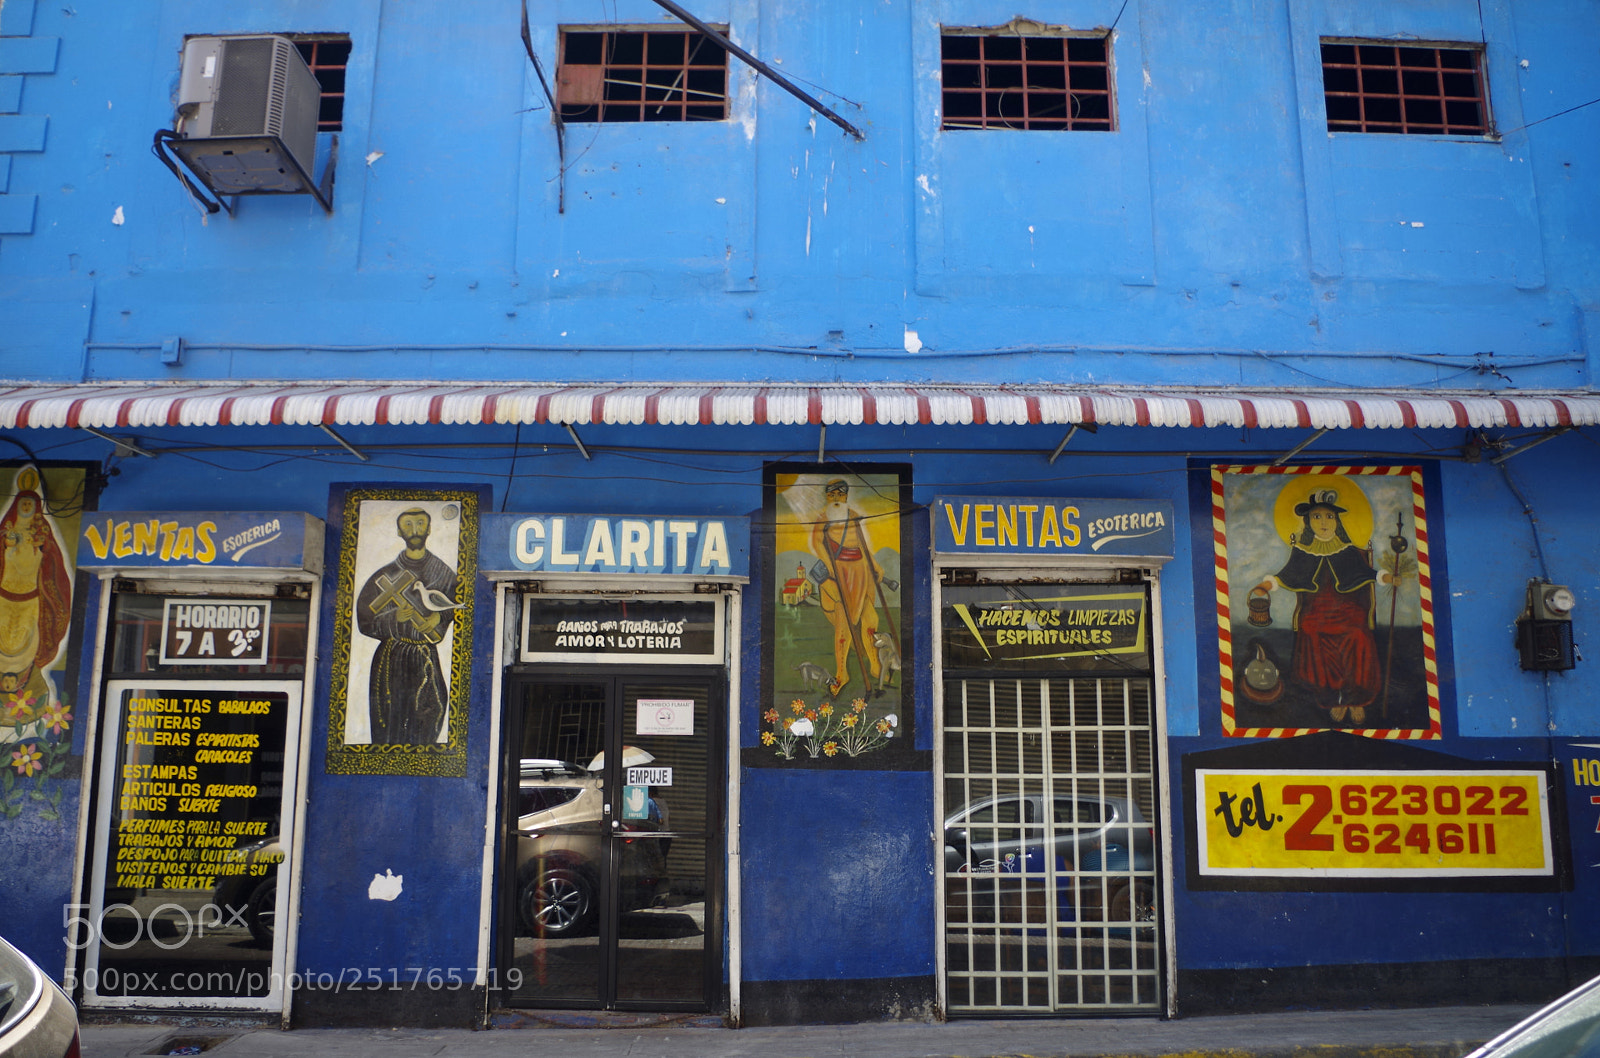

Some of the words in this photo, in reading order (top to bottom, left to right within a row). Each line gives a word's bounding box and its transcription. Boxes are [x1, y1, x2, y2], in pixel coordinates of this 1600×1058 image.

[944, 503, 1081, 548] VENTAS
[1088, 511, 1165, 539] ESOTERICA
[84, 518, 217, 564] VENTAS
[222, 518, 281, 553] ESOTERICA
[509, 517, 731, 574] CLARITA
[176, 605, 260, 628] HORARIO
[978, 609, 1061, 627] HACEMOS
[1068, 609, 1137, 626] LIMPIEZAS
[556, 620, 599, 633] BAÑOS
[619, 619, 684, 635] TRABAJOS
[176, 630, 192, 656] 7
[198, 631, 216, 656] A
[555, 634, 606, 648] AMOR
[607, 635, 615, 647] Y
[618, 635, 682, 649] LOTERIA
[996, 629, 1113, 646] ESPIRITUALES
[128, 698, 212, 714] CONSULTAS
[218, 700, 271, 715] BABALAOS
[127, 715, 202, 730] SANTERAS
[125, 731, 191, 746] PALERAS
[195, 732, 260, 748] ESPIRITISTAS
[195, 749, 253, 764] CARACOLES
[123, 764, 198, 780] ESTAMPAS
[629, 769, 668, 784] EMPUJE
[121, 781, 201, 797] ARTICULOS
[204, 783, 258, 798] RELIGIOSO
[120, 797, 167, 812] BAÑOS
[177, 798, 221, 813] SUERTE
[1214, 782, 1284, 838] tel.
[118, 818, 185, 834] PERFUMES
[186, 820, 208, 834] PARA
[223, 821, 268, 836] SUERTE
[118, 834, 184, 847] TRABAJOS
[187, 836, 194, 847] Y
[194, 835, 237, 848] AMOR
[1342, 822, 1497, 855] 624611
[117, 848, 178, 861] DESPOJO
[179, 849, 199, 862] PARA
[116, 862, 187, 874] VISITENOS
[189, 863, 196, 874] Y
[196, 863, 247, 875] CAMBIE
[249, 864, 268, 876] SU
[116, 874, 156, 888] MALA
[162, 876, 216, 890] SUERTE
